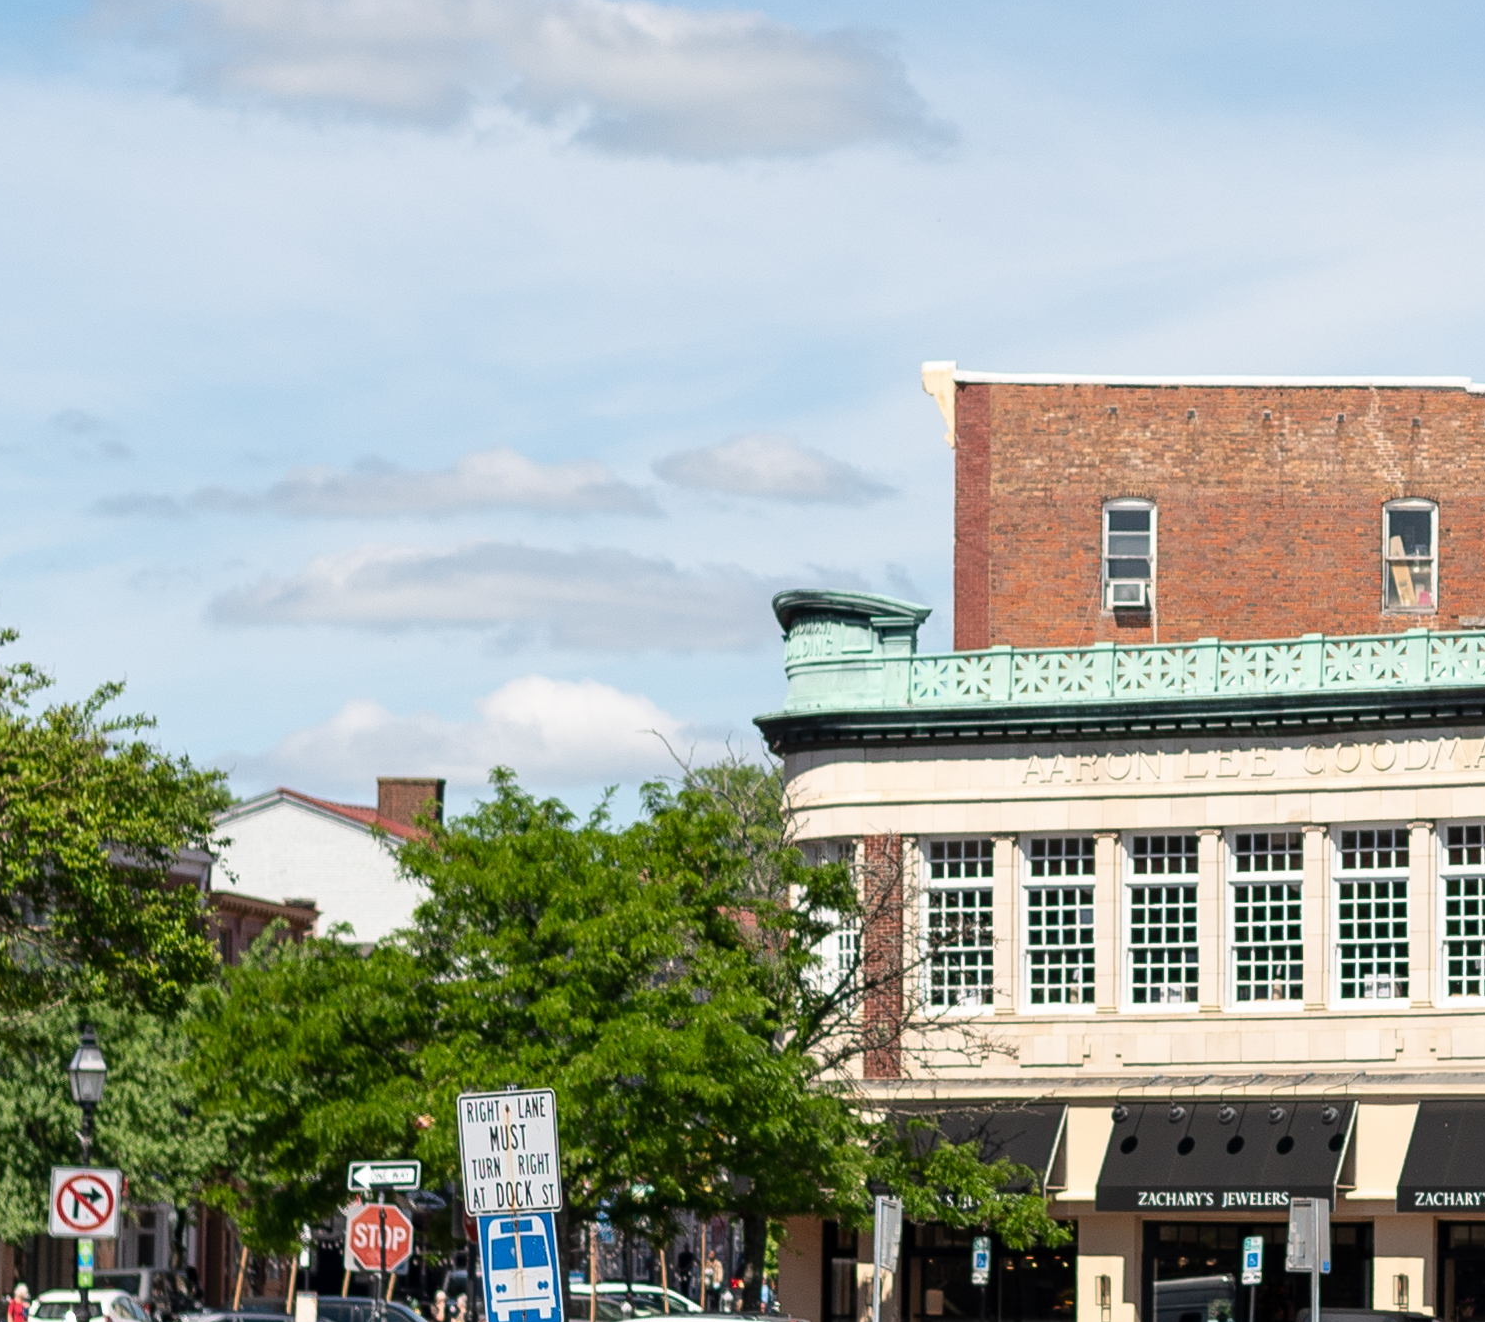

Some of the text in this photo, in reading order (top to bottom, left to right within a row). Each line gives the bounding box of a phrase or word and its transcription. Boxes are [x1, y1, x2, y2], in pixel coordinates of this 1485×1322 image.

[467, 1096, 546, 1123] RIGHT LANE
[490, 1124, 526, 1152] MUST
[472, 1153, 550, 1180] TURN RIGHT
[474, 1180, 554, 1209] AT DOCK ST
[1137, 1191, 1290, 1208] ZACHARY'S JEWELERS
[353, 1222, 407, 1252] STOP
